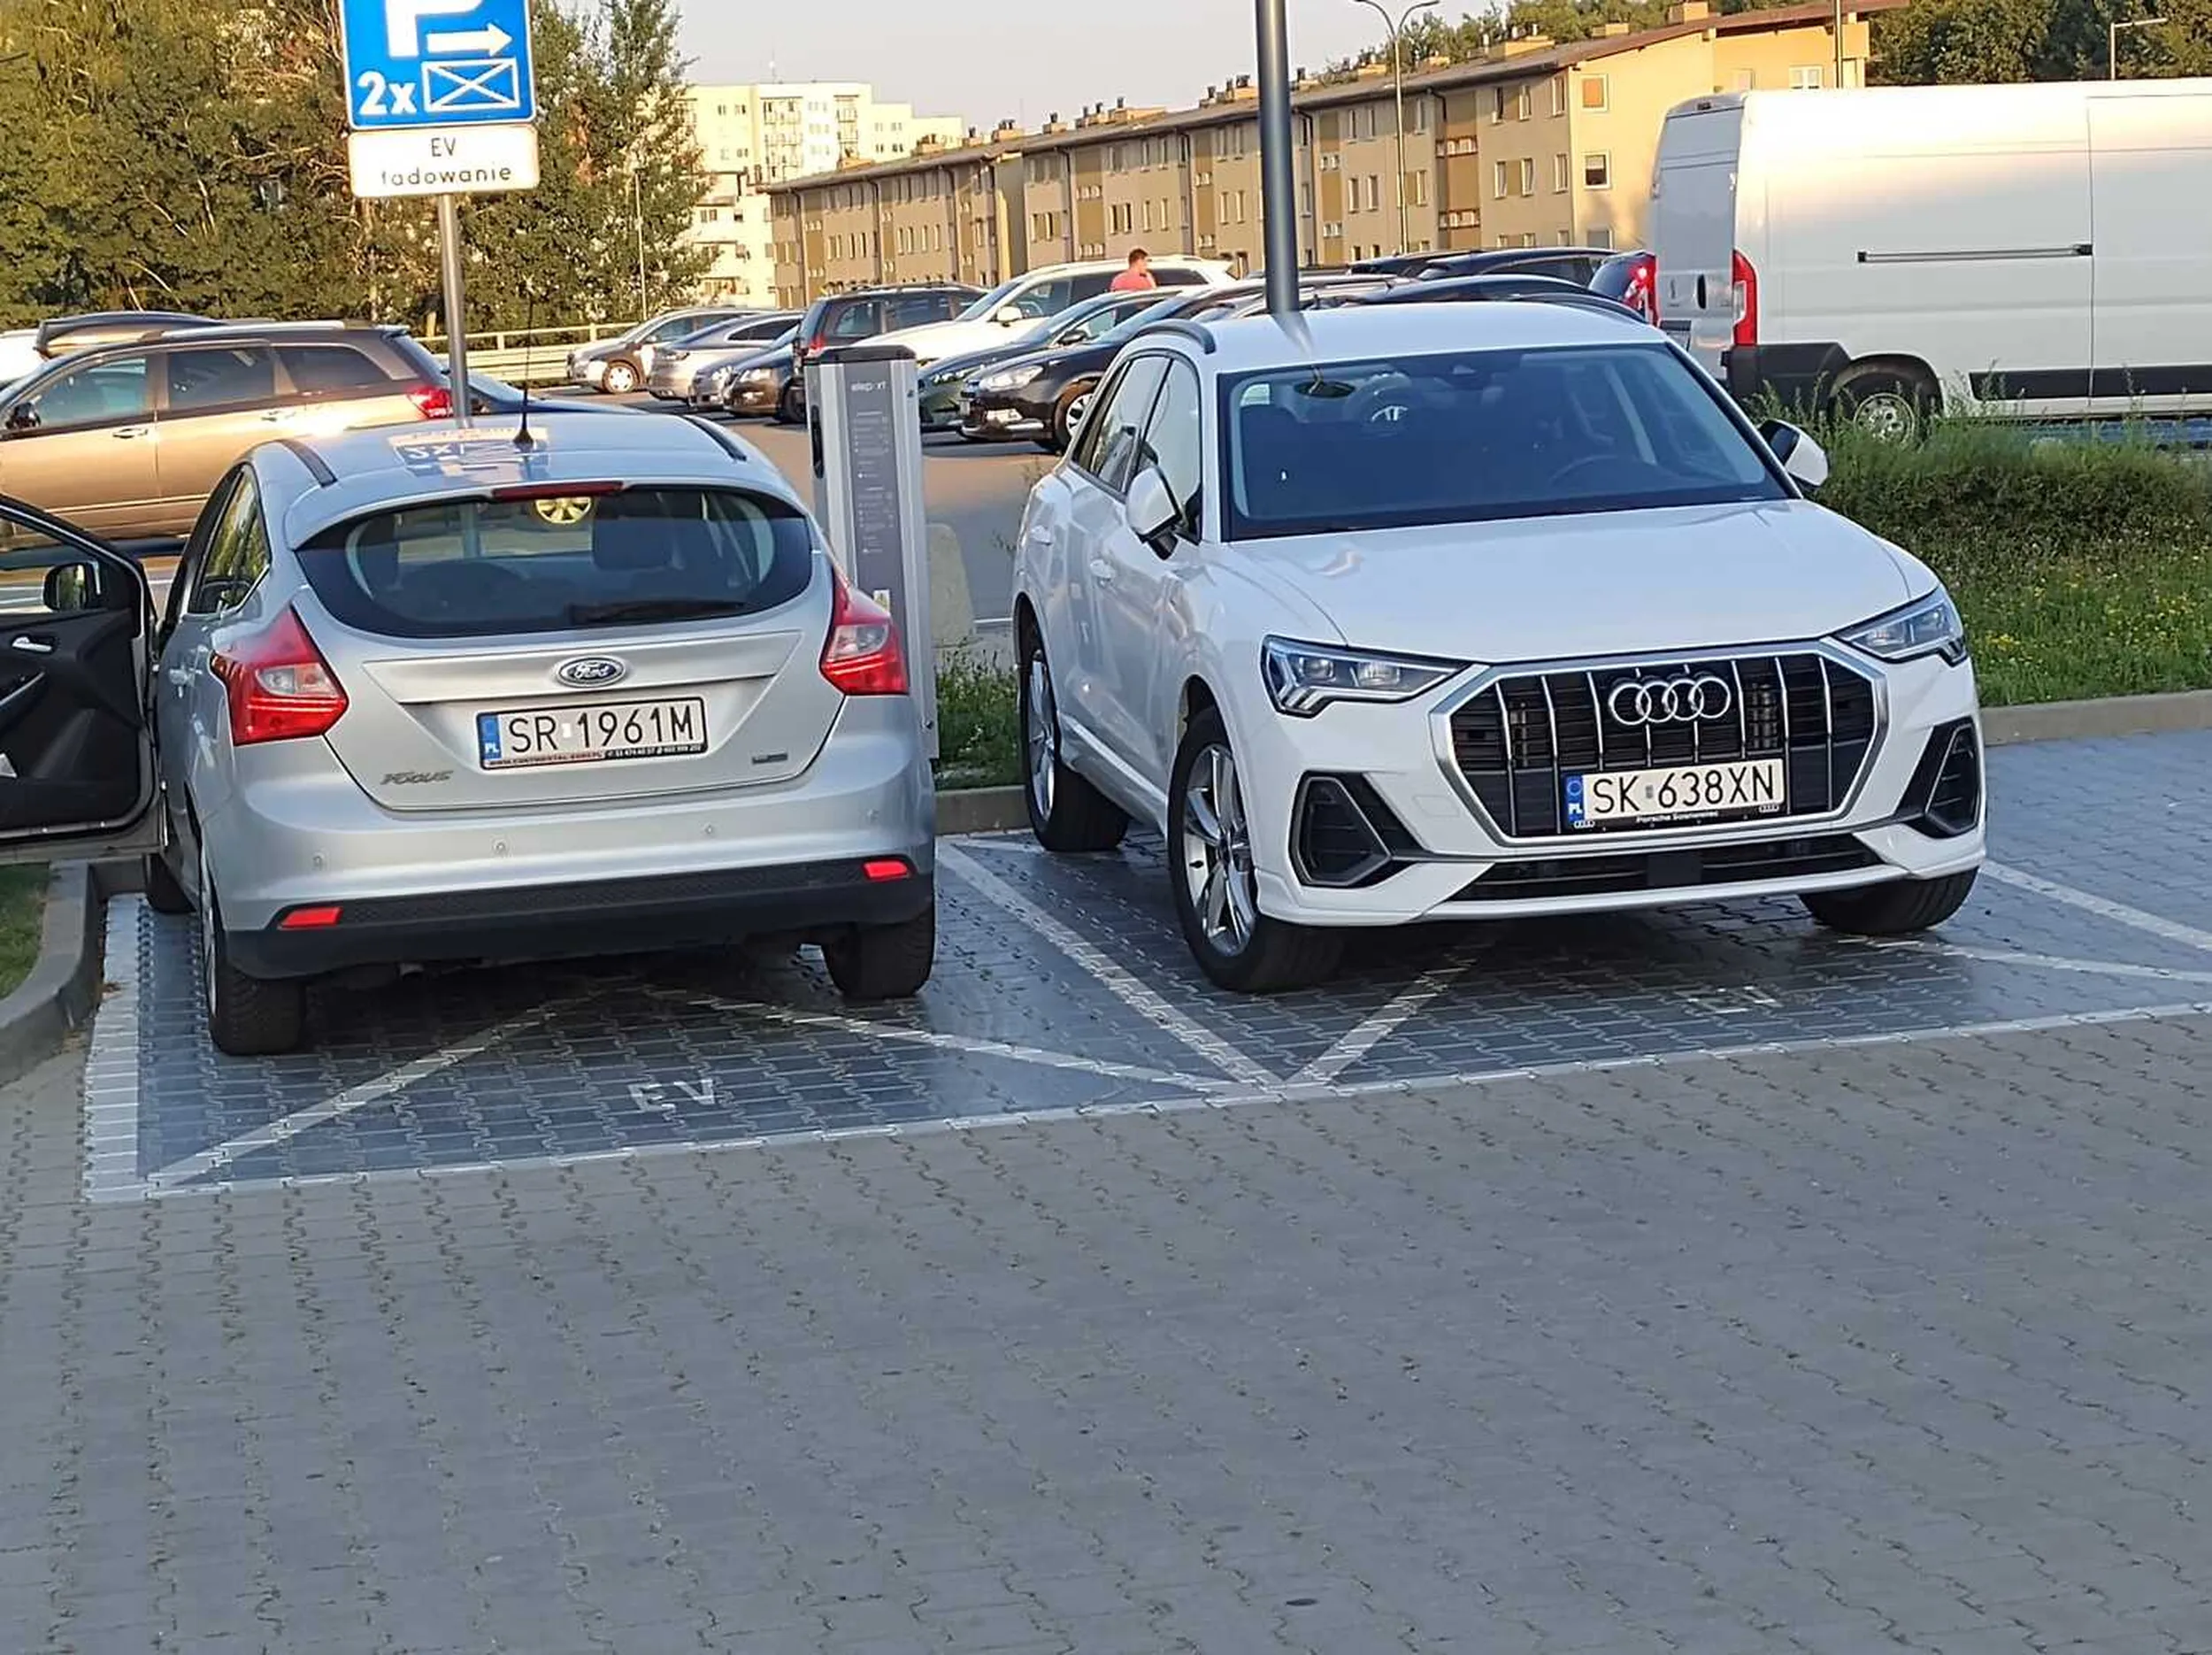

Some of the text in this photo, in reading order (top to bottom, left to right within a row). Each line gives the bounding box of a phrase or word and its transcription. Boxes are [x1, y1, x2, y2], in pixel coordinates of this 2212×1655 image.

[357, 71, 417, 115] 2x
[431, 137, 456, 157] EV
[508, 704, 695, 753] SR 1961M
[485, 742, 500, 753] PL
[1593, 764, 1774, 813] SK 638XN
[1568, 802, 1583, 814] PL
